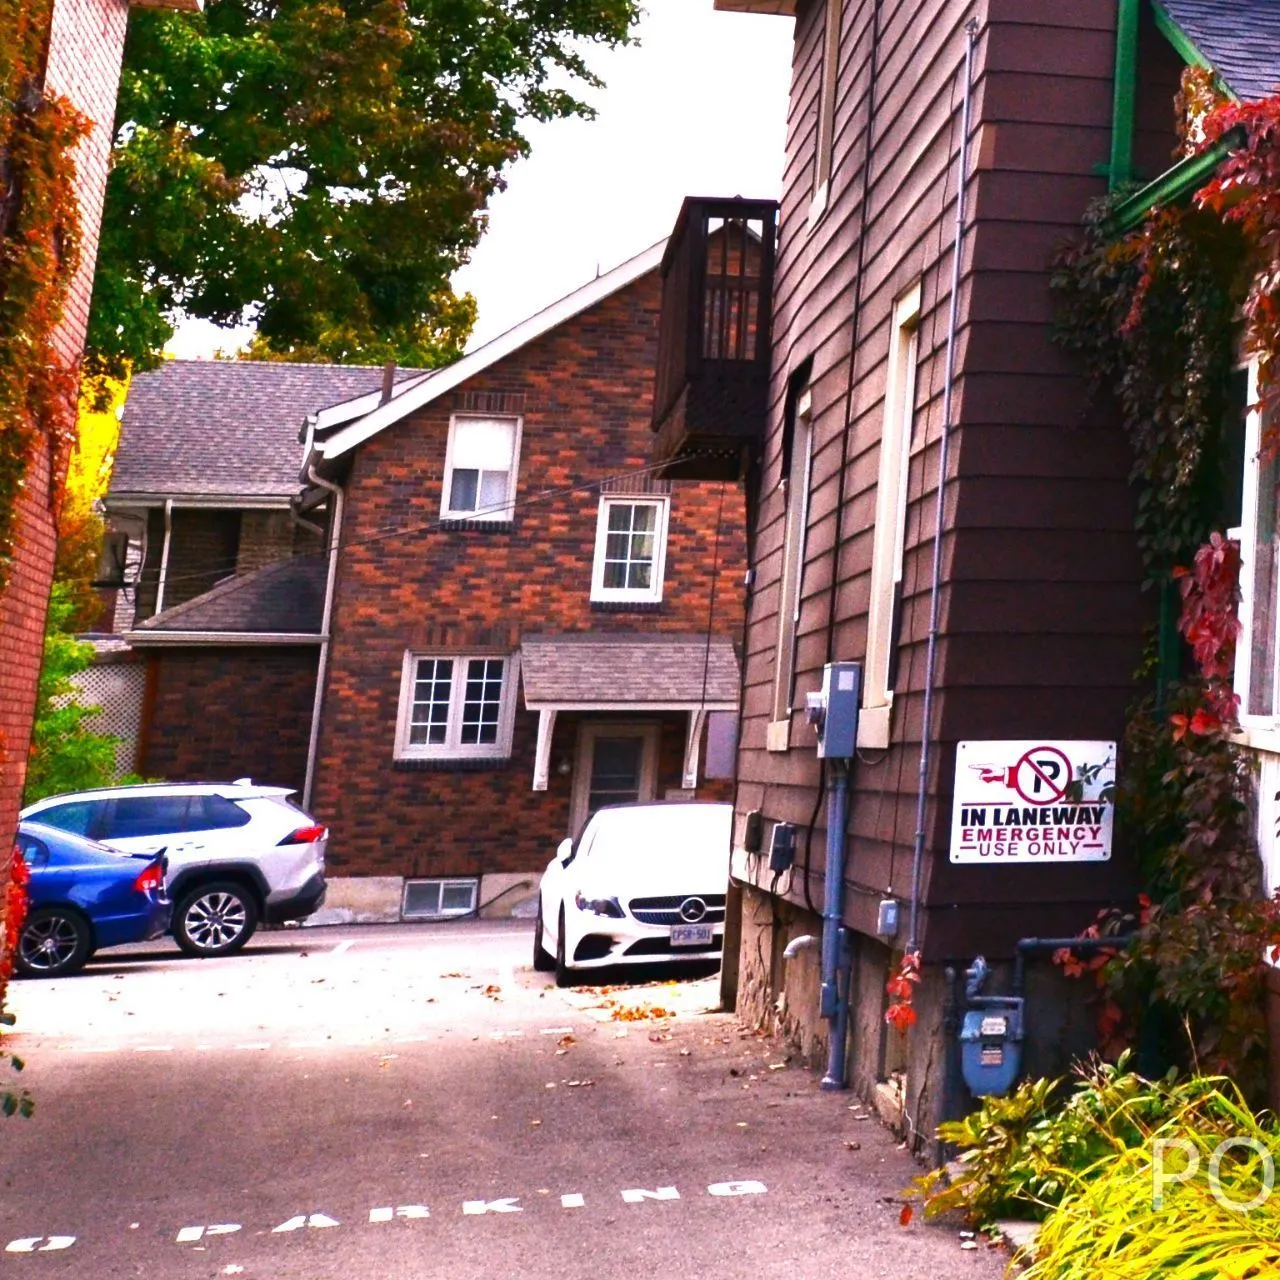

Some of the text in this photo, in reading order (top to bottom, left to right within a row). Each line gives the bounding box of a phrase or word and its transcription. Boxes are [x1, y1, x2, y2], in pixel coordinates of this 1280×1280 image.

[961, 807, 1106, 826] IN LANEWAY
[962, 826, 1102, 842] EMERGENCY
[979, 841, 1080, 856] USE ONLY
[176, 1180, 769, 1242] PARKING
